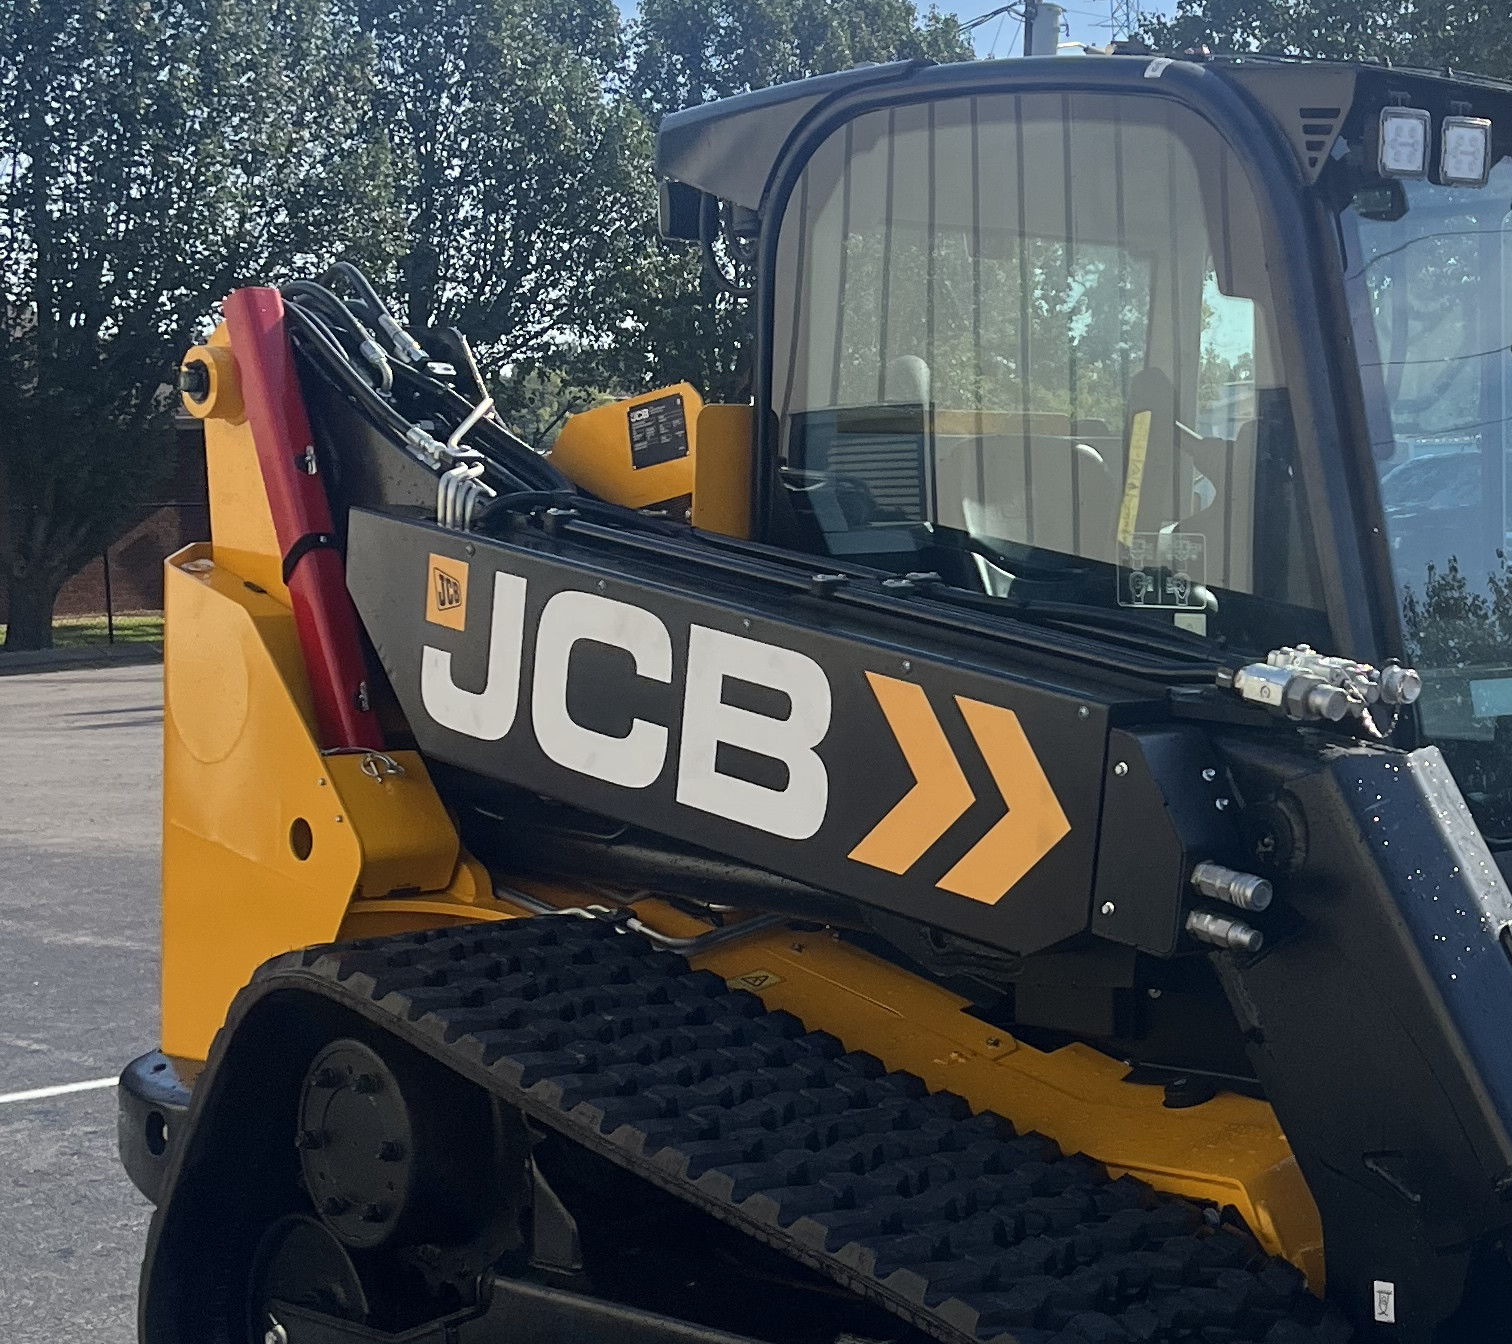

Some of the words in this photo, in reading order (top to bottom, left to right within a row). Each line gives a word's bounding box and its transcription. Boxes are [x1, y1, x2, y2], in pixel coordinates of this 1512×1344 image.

[629, 408, 650, 423] JCB
[438, 573, 461, 607] JCB
[421, 571, 832, 840] JCB
